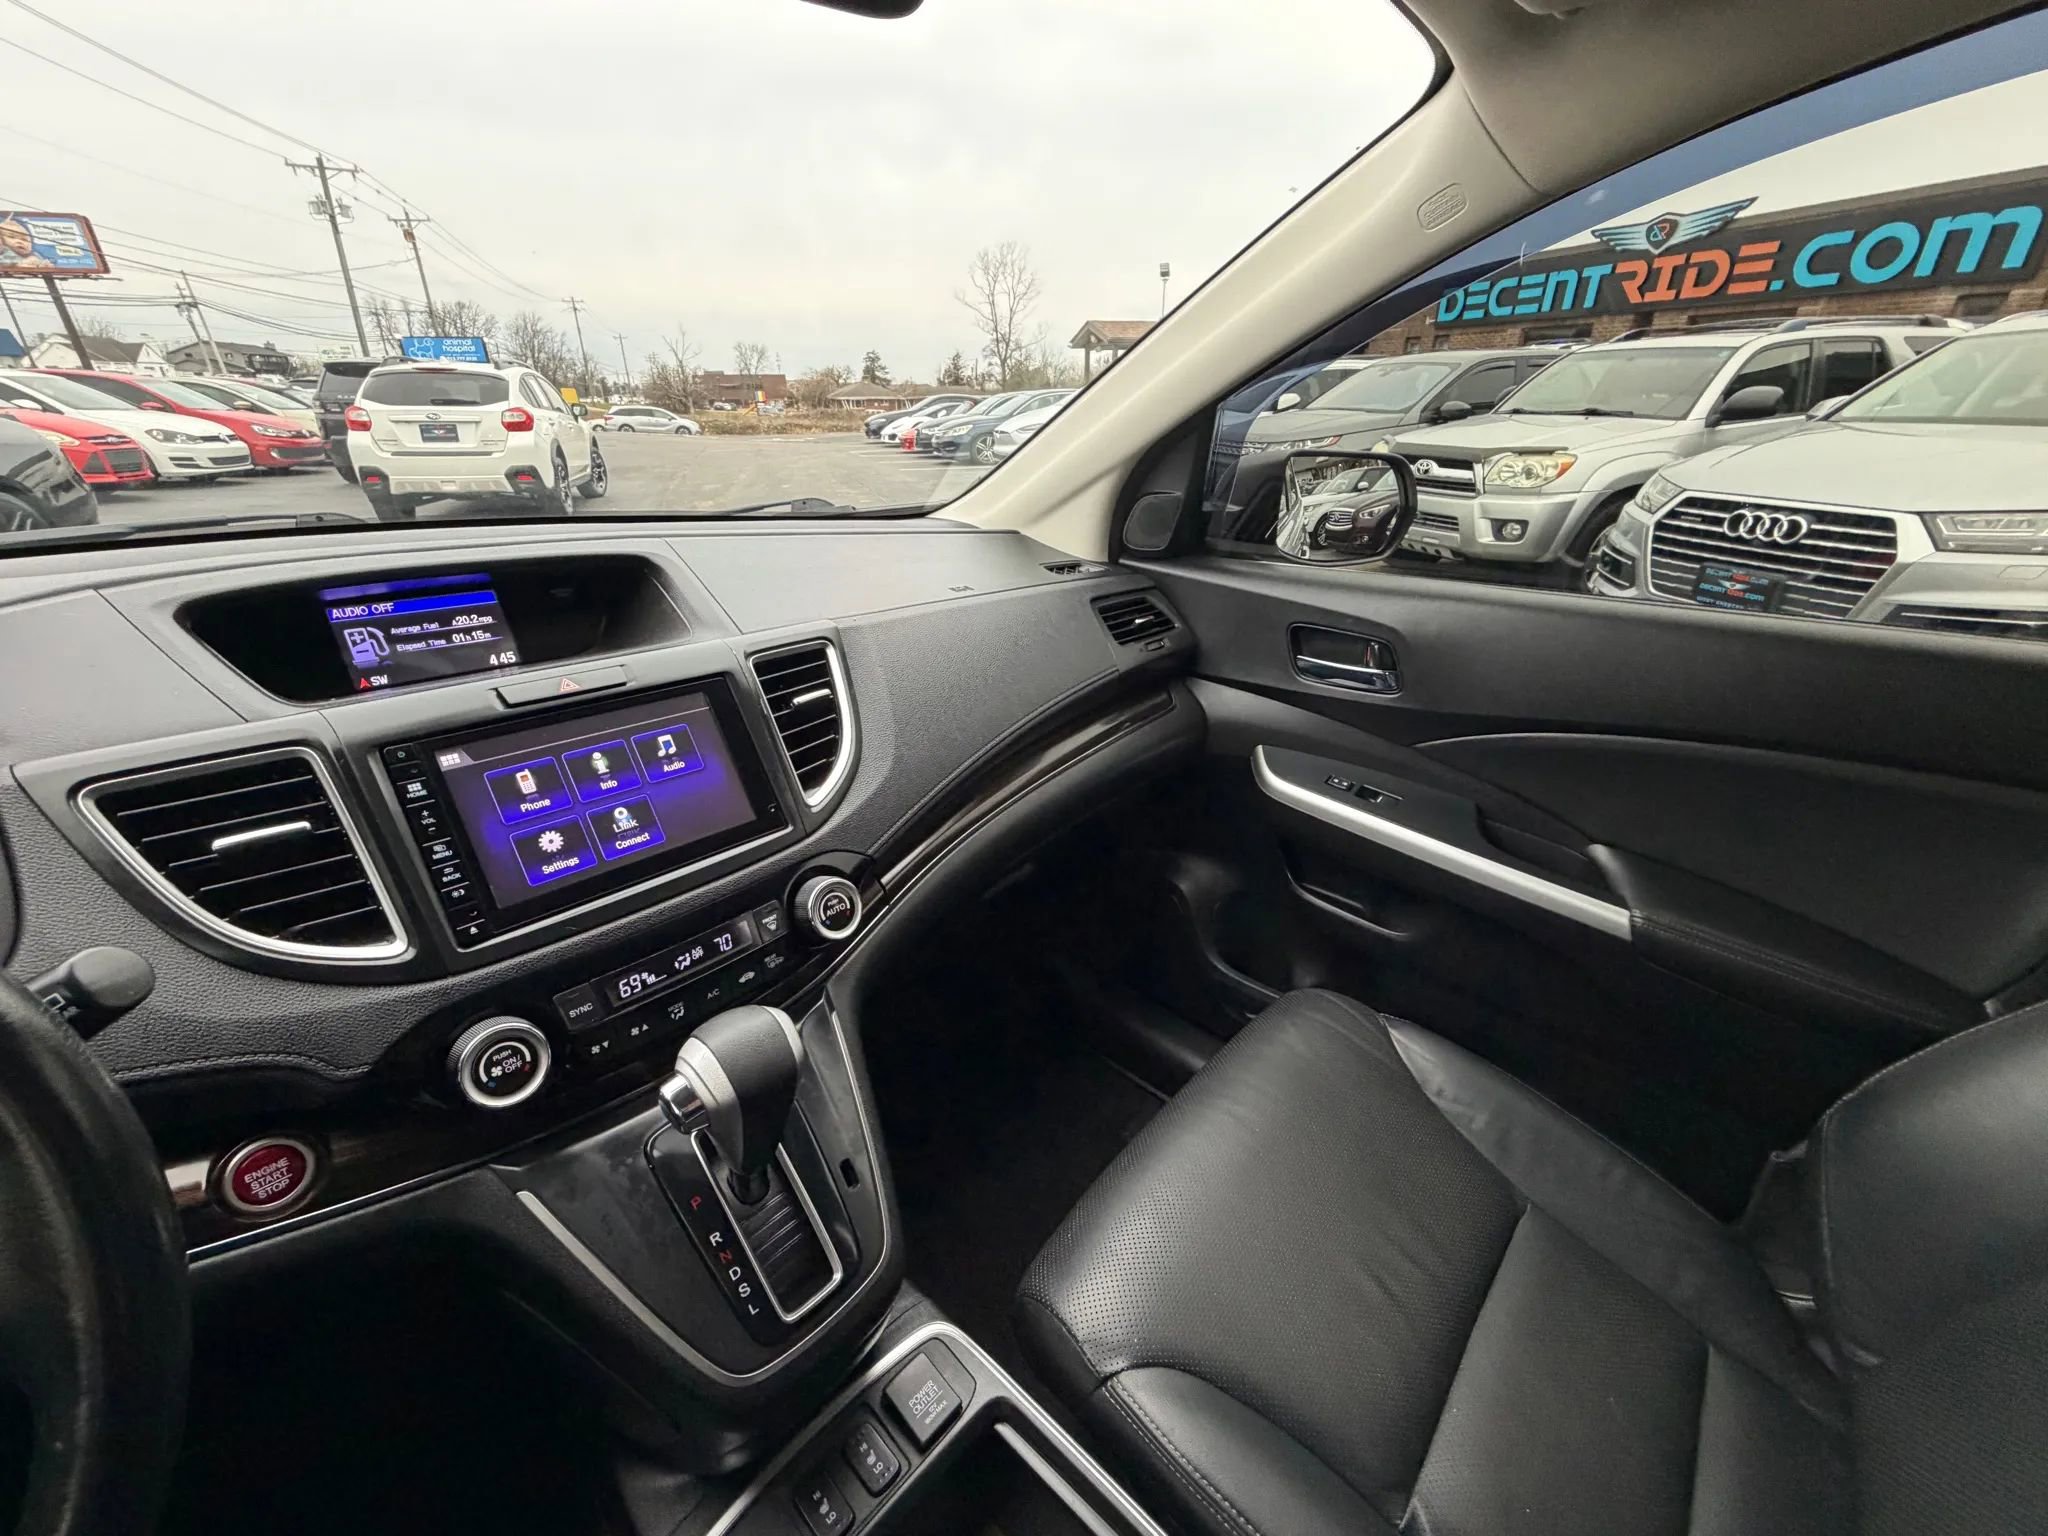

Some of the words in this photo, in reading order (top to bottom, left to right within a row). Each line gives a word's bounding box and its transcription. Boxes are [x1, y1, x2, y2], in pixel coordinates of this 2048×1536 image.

[332, 606, 368, 619] AUDIO
[372, 603, 394, 614] OFF
[390, 625, 421, 635] Average
[423, 622, 440, 630] Fuel
[396, 641, 426, 652] Elapsed
[428, 638, 446, 648] Time
[370, 675, 389, 686] SW
[663, 760, 686, 773] Audio
[600, 780, 618, 791] Info
[407, 790, 428, 799] HOME
[520, 798, 551, 813] Phone
[613, 819, 640, 833] Link
[615, 832, 650, 849] Connect
[432, 850, 453, 860] MENU
[541, 857, 580, 875] Settings
[442, 872, 461, 883] BACK
[826, 903, 846, 917] AUTO
[713, 933, 733, 952] 70
[619, 974, 642, 999] 69
[707, 988, 720, 1000] A/C
[569, 1002, 593, 1018] SYNC
[492, 1049, 512, 1062] PUSH
[505, 1060, 523, 1073] OFF
[244, 1157, 291, 1184] ENGINE
[250, 1166, 289, 1190] START
[258, 1178, 290, 1199] STOP
[690, 1196, 702, 1210] P
[709, 1231, 724, 1247] R
[728, 1266, 742, 1281] D
[738, 1283, 751, 1298] S
[748, 1302, 760, 1316] L
[909, 1379, 935, 1408] POWER
[913, 1385, 939, 1415] OUTLET
[873, 1461, 884, 1474] LO
[825, 1511, 837, 1524] LO
